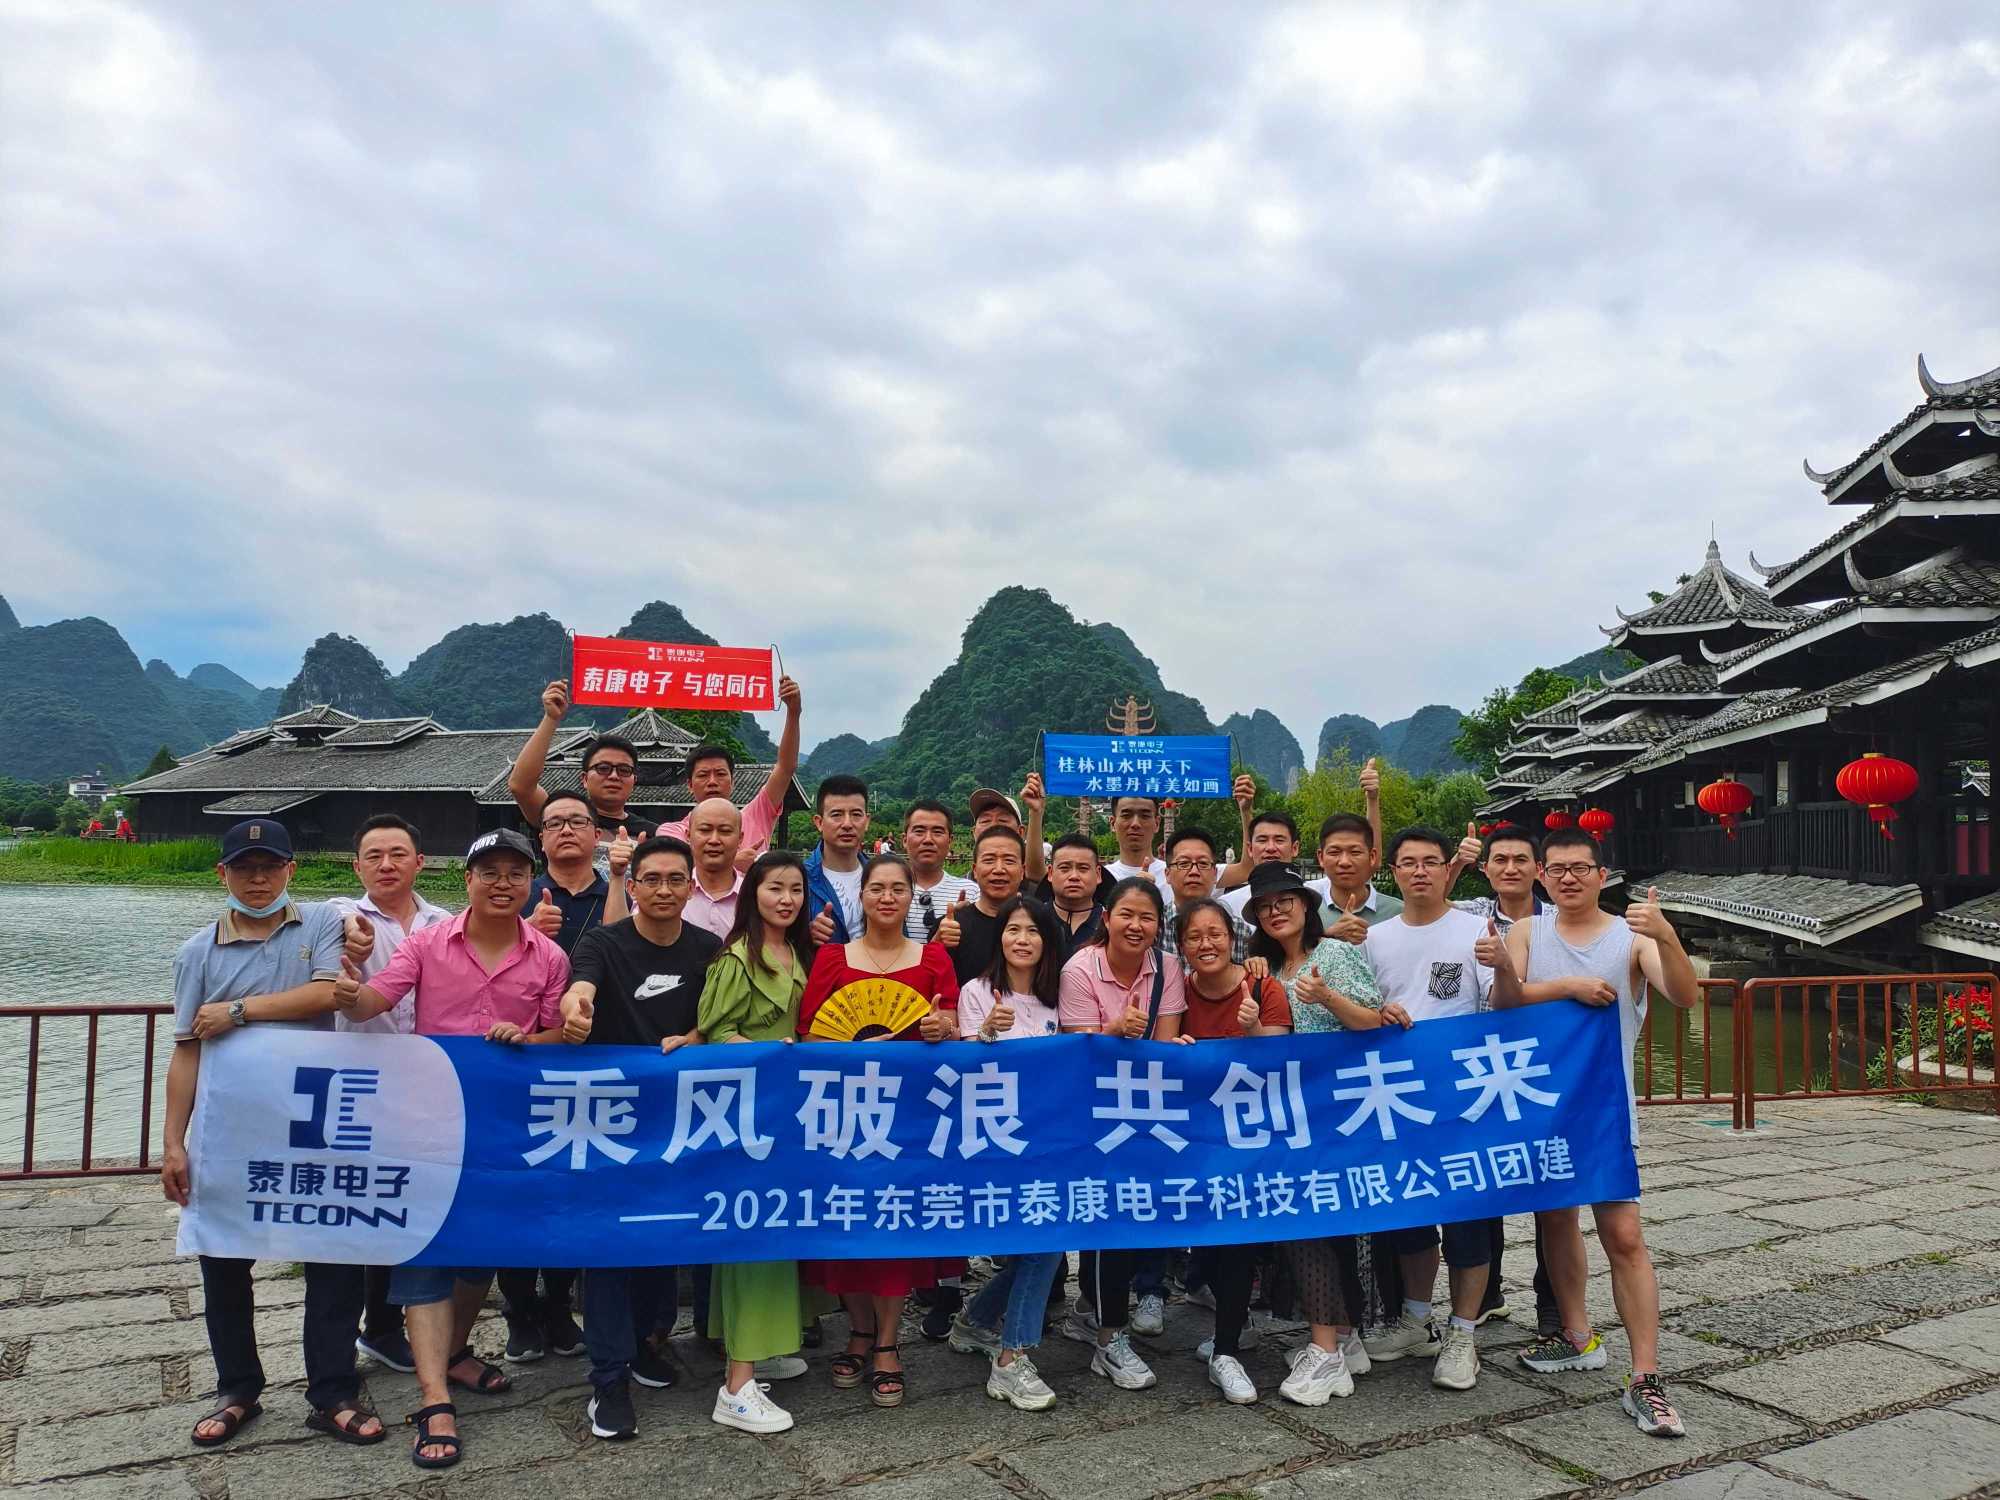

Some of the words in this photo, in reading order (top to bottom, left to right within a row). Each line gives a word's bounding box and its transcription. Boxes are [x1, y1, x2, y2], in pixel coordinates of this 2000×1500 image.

[582, 667, 673, 695] 泰康电子
[683, 671, 768, 699] 与您同行
[1058, 757, 1192, 775] 桂林山水甲天下
[1086, 776, 1219, 794] 水墨丹青美如画
[521, 1060, 1030, 1170] 乘风破浪
[1092, 1033, 1561, 1155] 共创未来
[247, 1160, 411, 1199] 泰康电子
[246, 1200, 408, 1229] TECONN
